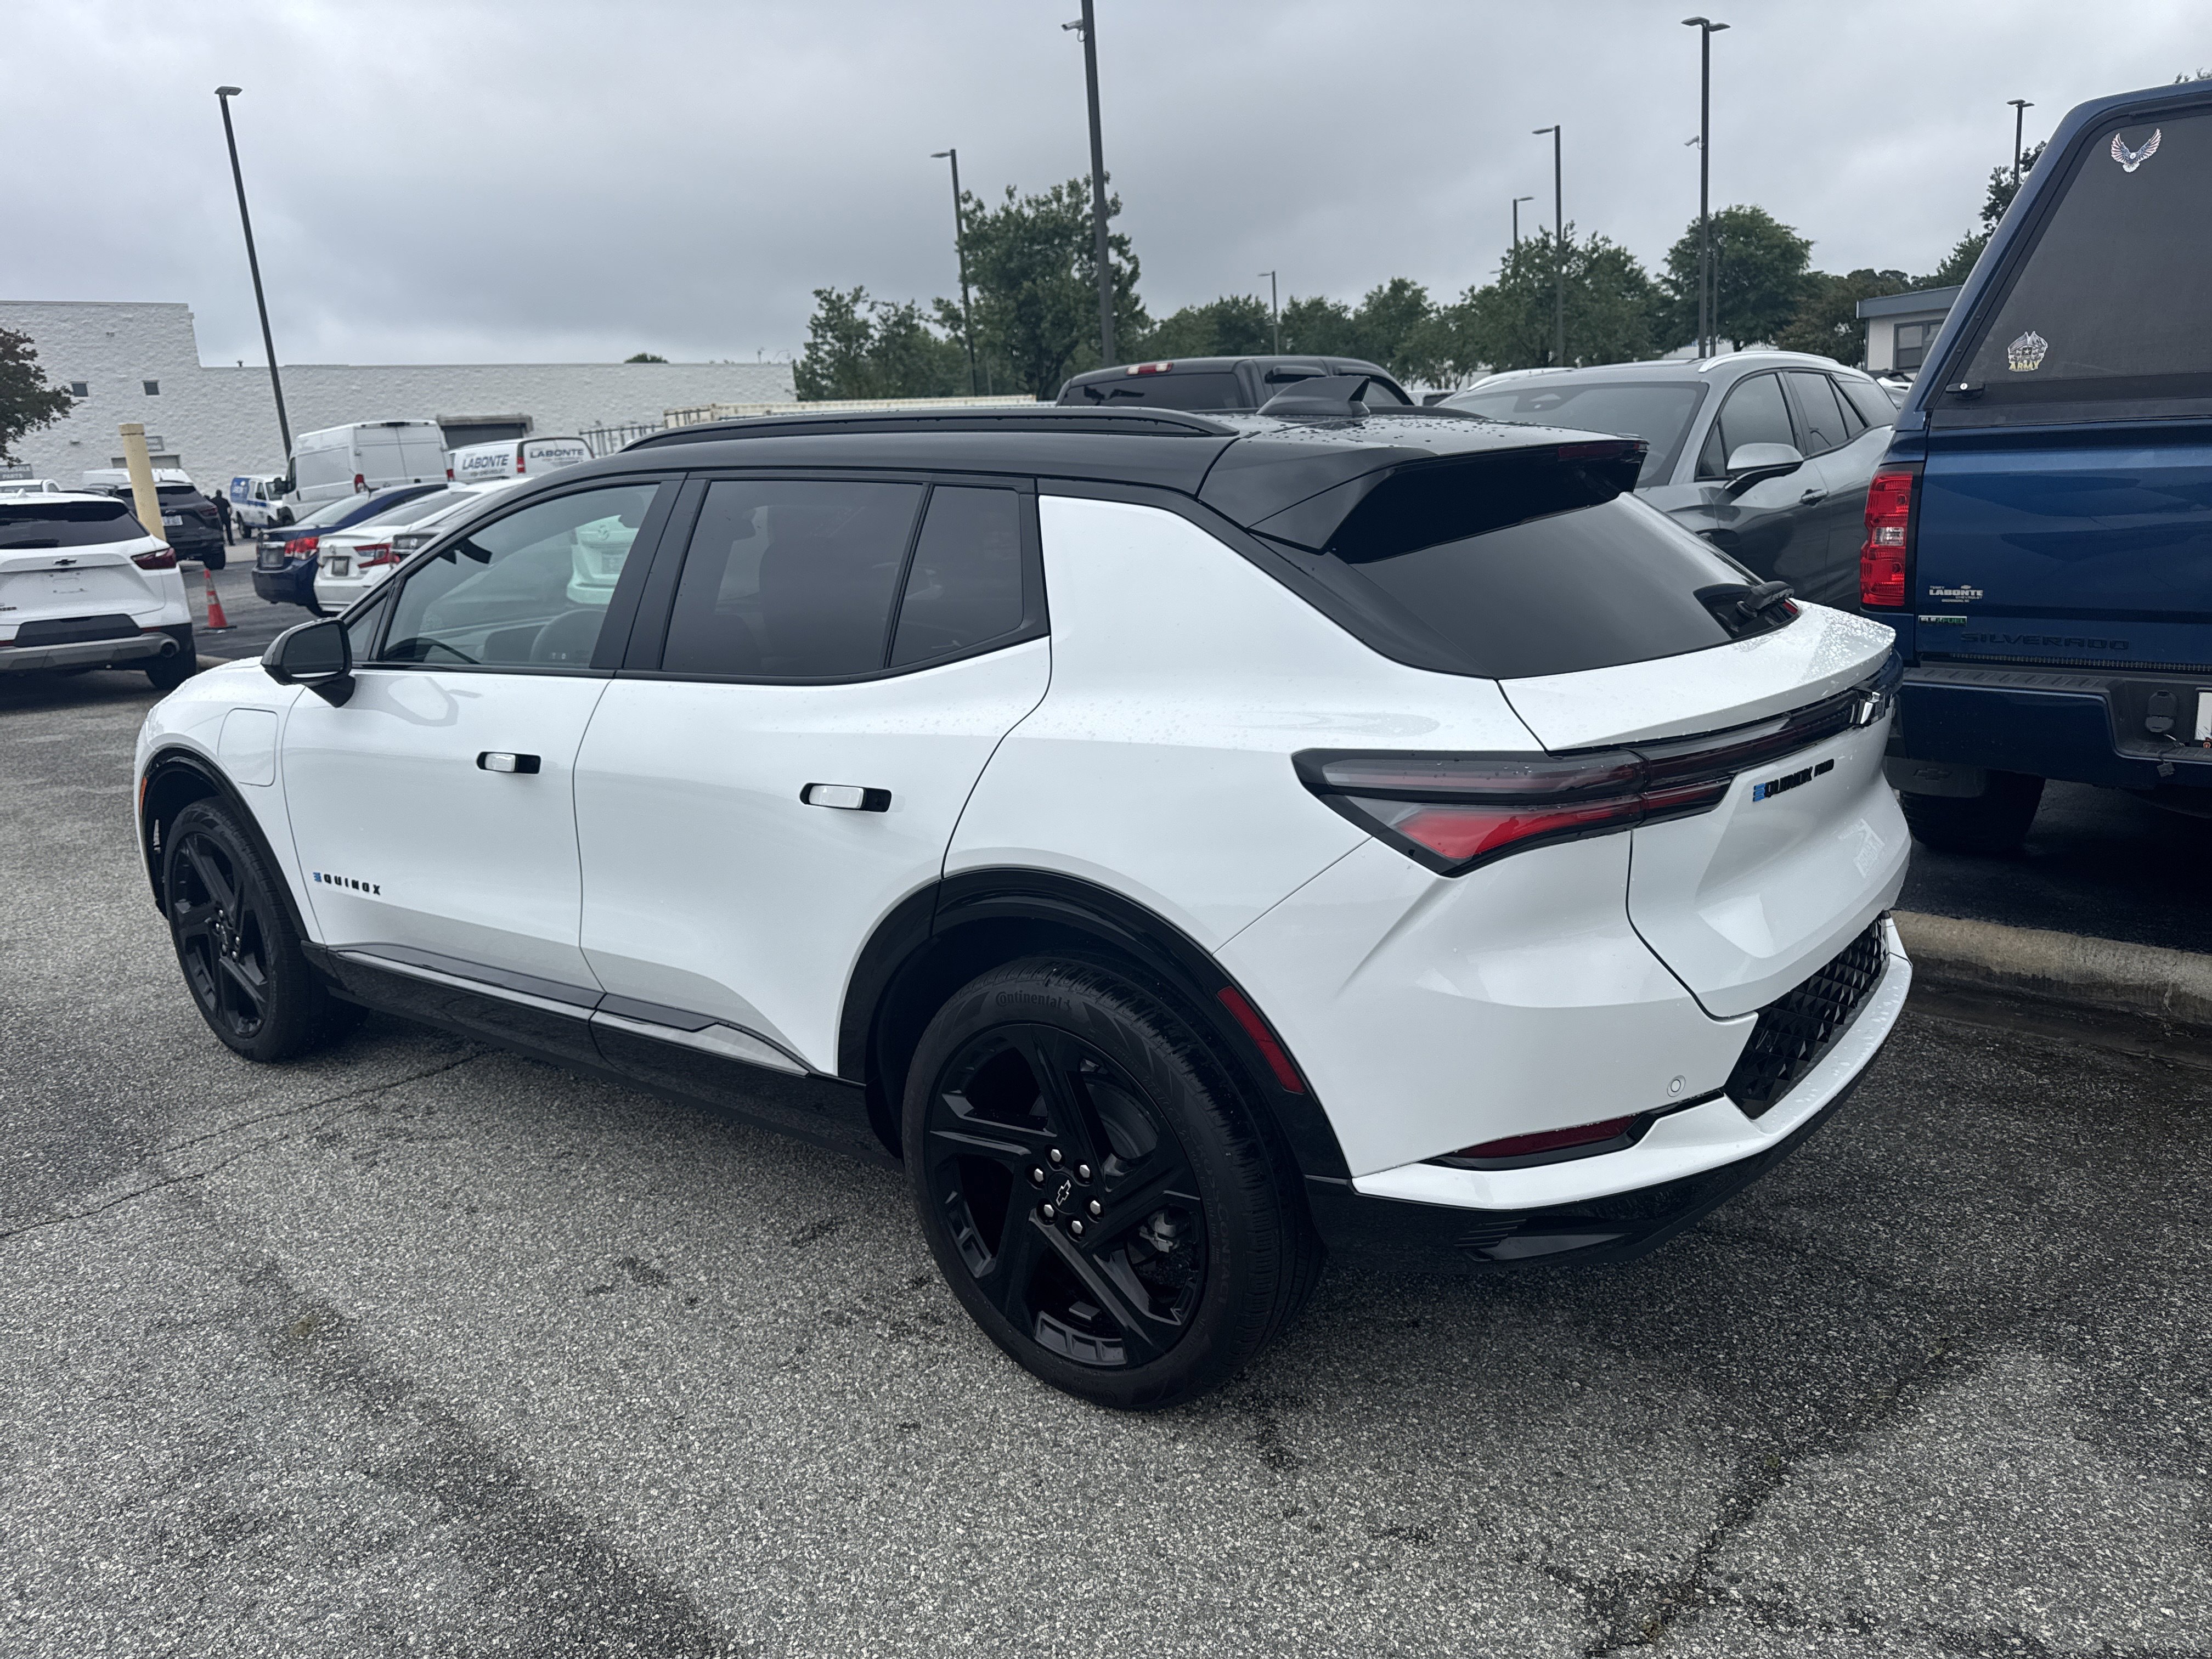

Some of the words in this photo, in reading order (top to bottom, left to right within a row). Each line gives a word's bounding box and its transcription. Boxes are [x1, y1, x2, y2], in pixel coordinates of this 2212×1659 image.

[2009, 359, 2039, 370] ARMY
[462, 454, 510, 470] LABONTE
[529, 448, 585, 459] LABONTE
[1960, 631, 2129, 650] SILVERADO
[1752, 766, 1813, 802] EQUINOX
[313, 872, 381, 896] EQUINOX
[995, 989, 1062, 1008] Continental
